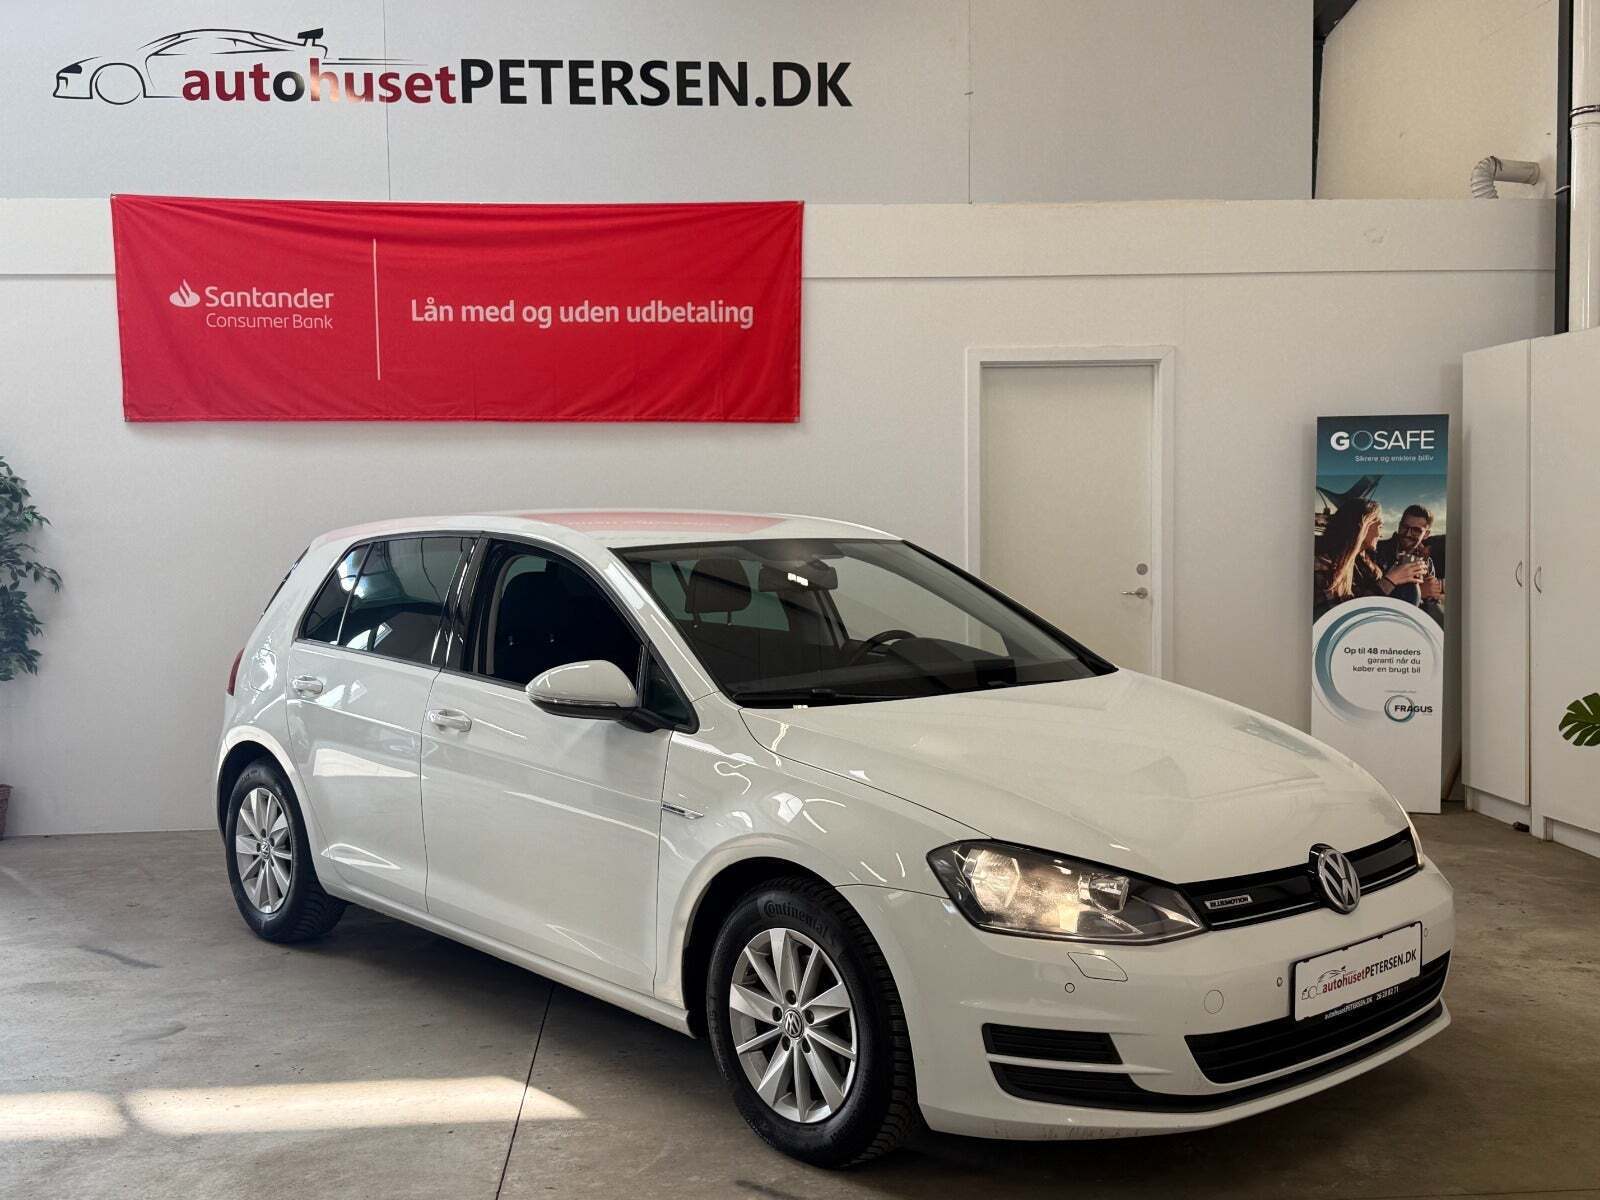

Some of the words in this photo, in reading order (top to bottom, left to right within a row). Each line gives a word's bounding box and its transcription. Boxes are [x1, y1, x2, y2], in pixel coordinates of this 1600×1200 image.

[181, 58, 853, 108] autohusetPETERSEN.DK
[205, 286, 334, 309] Santander
[206, 312, 289, 329] Consumer
[292, 313, 333, 329] Bank
[411, 297, 454, 322] Lån
[461, 300, 515, 323] med
[522, 303, 552, 329] og
[559, 300, 620, 323] uden
[626, 300, 754, 329] udbetaling
[1330, 430, 1435, 451] GOSAFE
[1344, 647, 1357, 656] Op
[1358, 647, 1366, 655] til
[1367, 647, 1379, 655] 48
[1380, 647, 1421, 656] måneders
[1367, 657, 1394, 665] garanti
[1396, 657, 1409, 665] når
[1410, 657, 1421, 665] du
[1388, 666, 1410, 674] brugt
[1411, 666, 1421, 674] bil
[1394, 704, 1433, 713] FRAGUS
[763, 900, 829, 938] Continental
[1322, 948, 1417, 994] autohusetPETERSEN.DK
